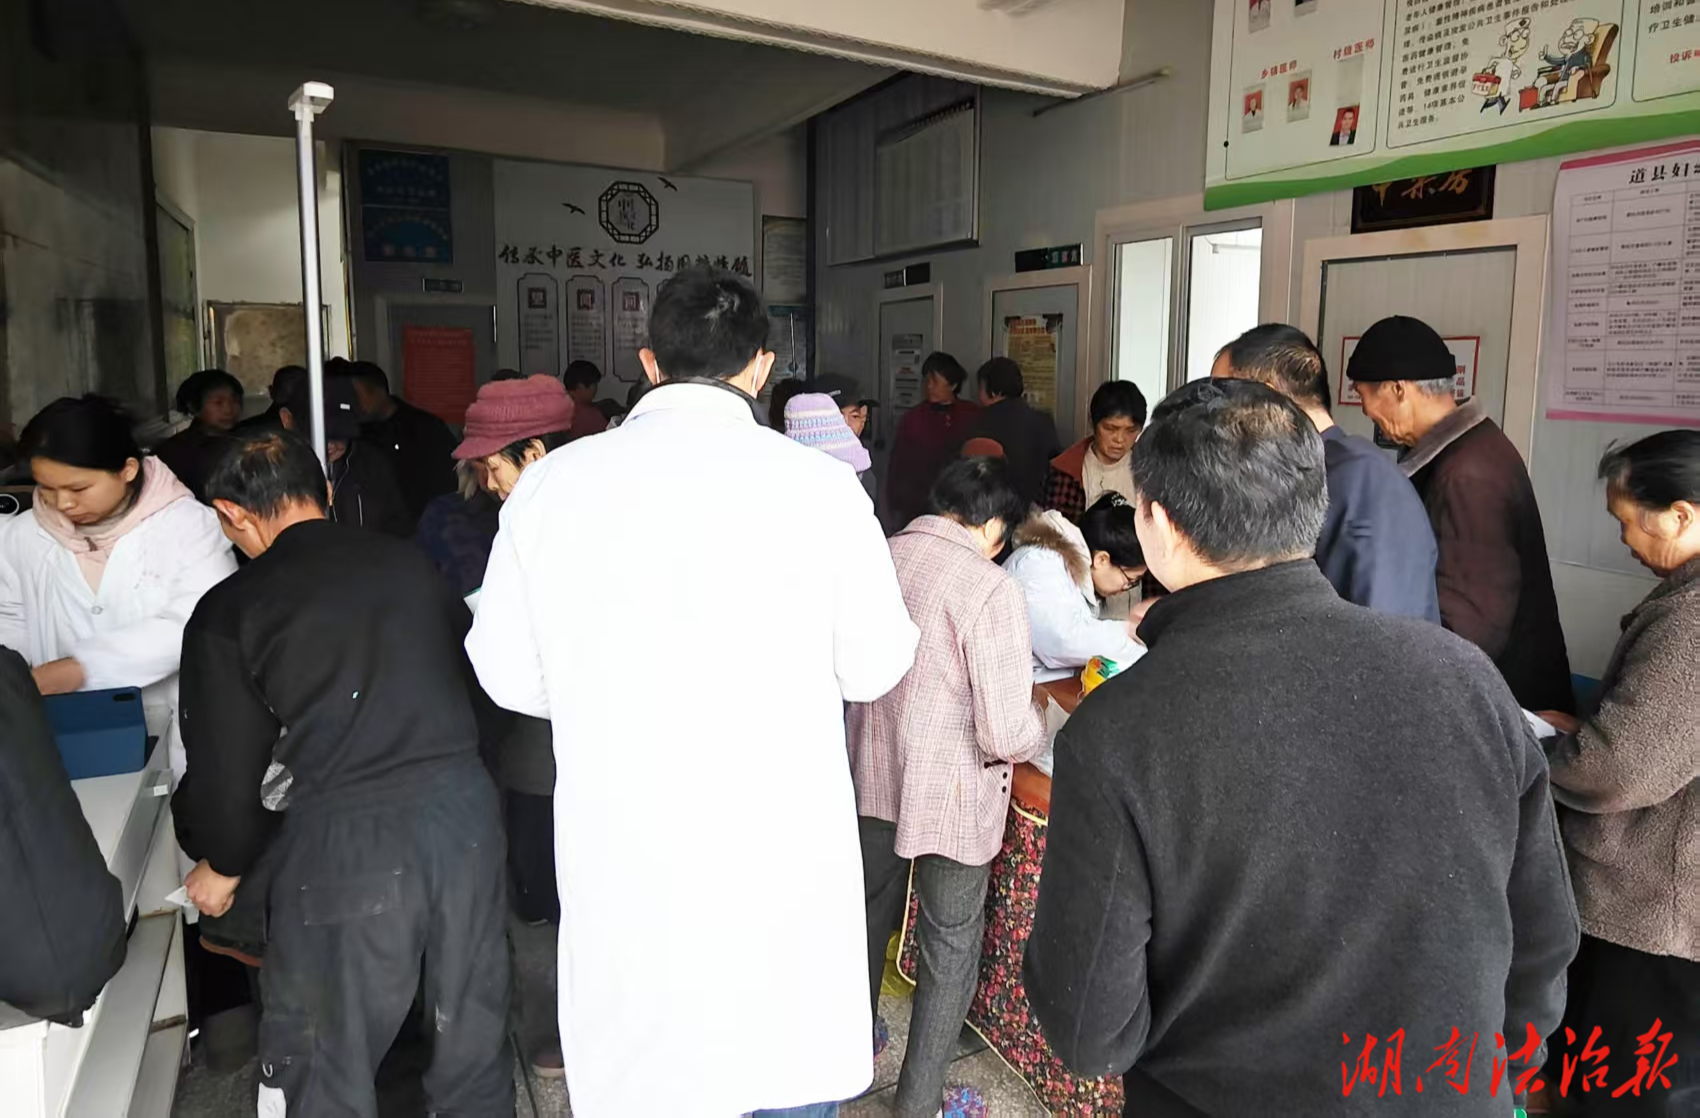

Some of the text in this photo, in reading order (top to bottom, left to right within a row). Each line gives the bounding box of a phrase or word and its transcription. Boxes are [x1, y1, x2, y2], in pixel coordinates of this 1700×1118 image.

[498, 244, 626, 269] 传承中医文化
